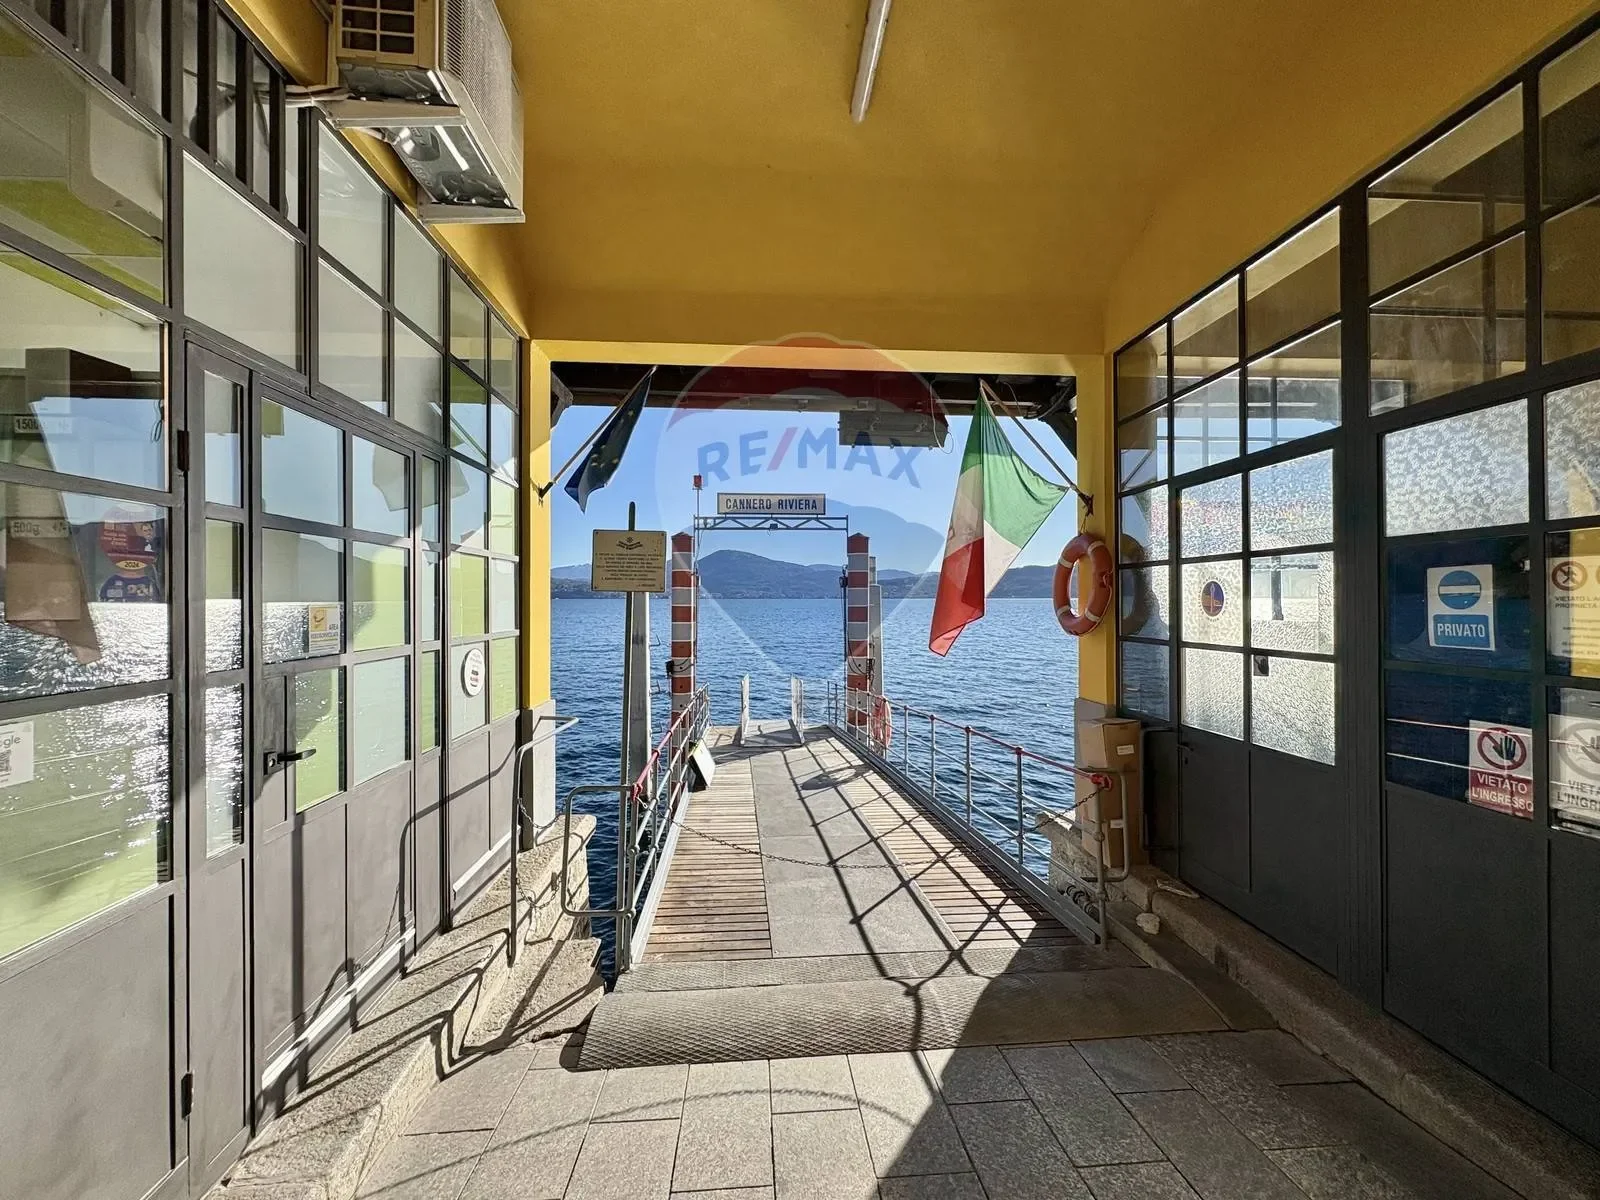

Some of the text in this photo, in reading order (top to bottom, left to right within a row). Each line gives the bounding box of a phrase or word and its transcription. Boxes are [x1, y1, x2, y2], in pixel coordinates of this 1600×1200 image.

[725, 498, 818, 511] CANNERO RIVIERA
[1437, 623, 1486, 638] PRIVATO
[0, 734, 21, 749] gle
[1477, 772, 1528, 794] VIETATO
[1471, 786, 1534, 812] L'INGRESSO
